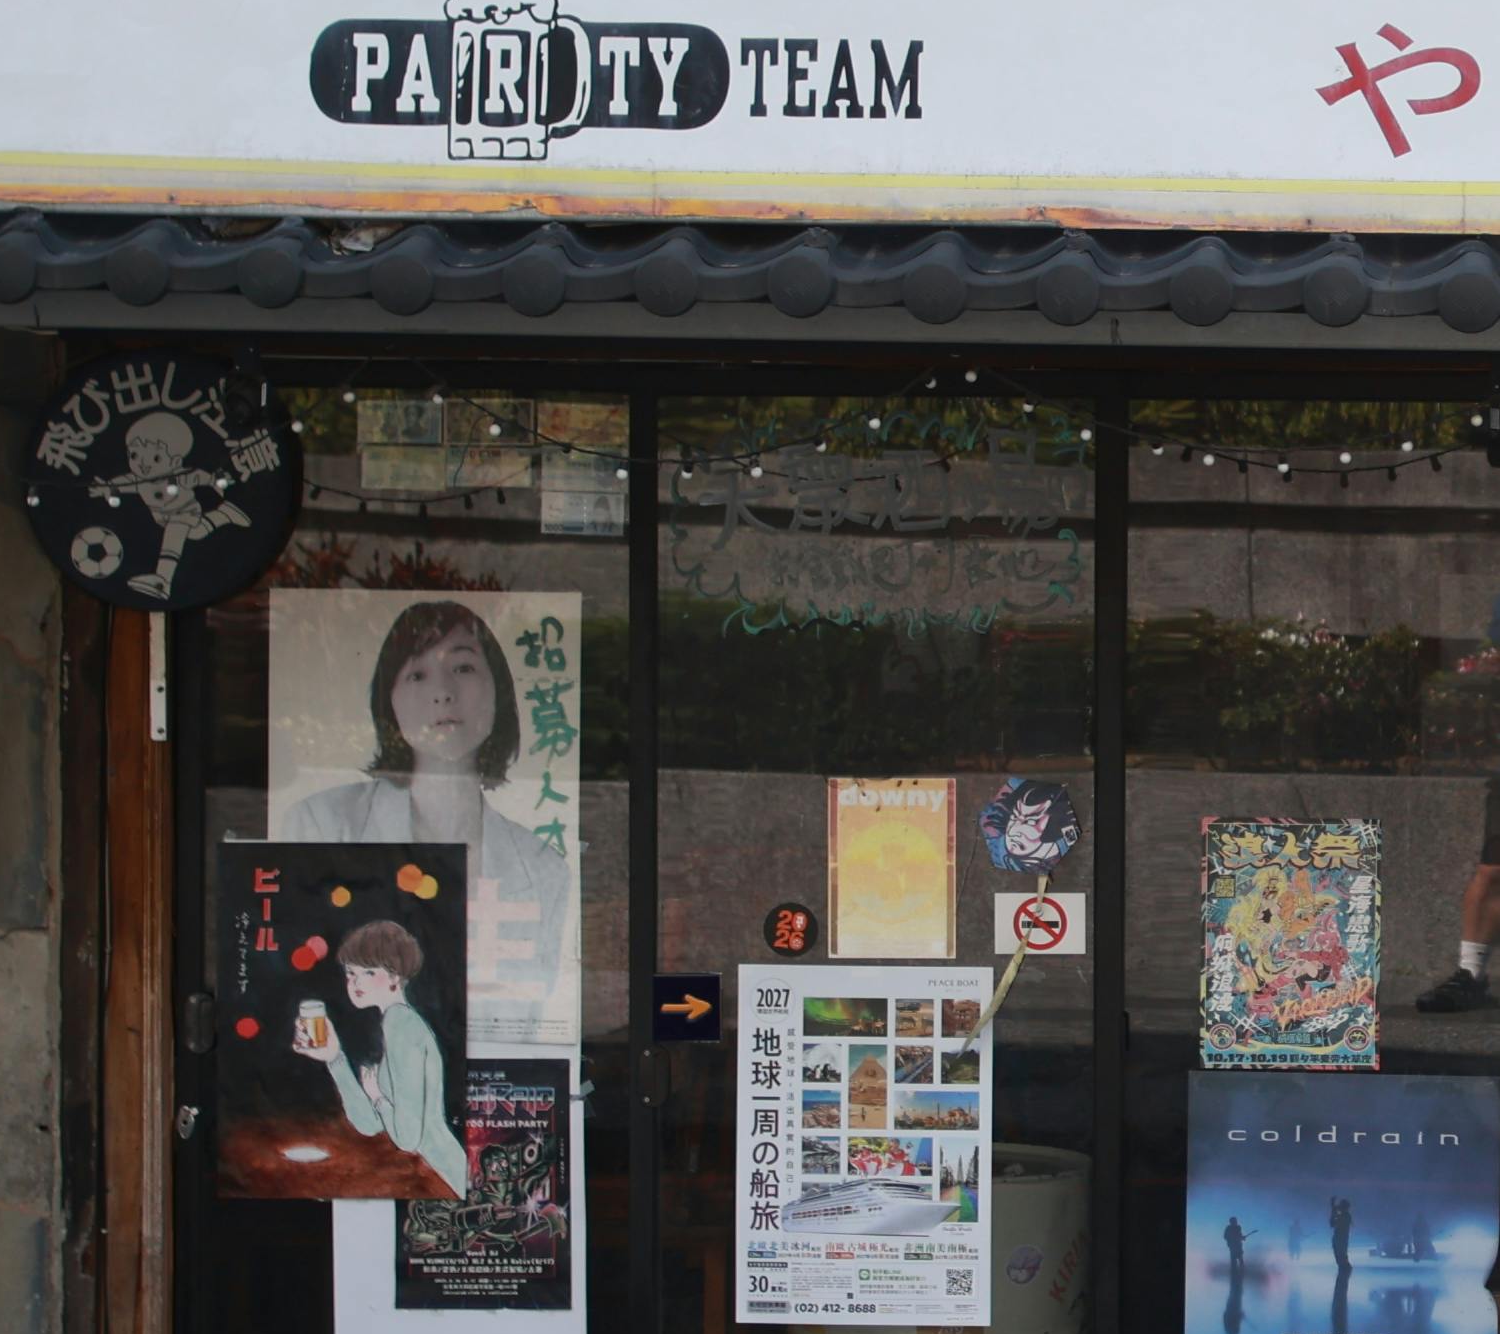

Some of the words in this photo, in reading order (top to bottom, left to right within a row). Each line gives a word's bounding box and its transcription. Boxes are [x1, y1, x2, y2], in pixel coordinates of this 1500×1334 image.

[741, 38, 925, 122] TEAM
[839, 787, 947, 813] downy
[253, 867, 281, 952] ビール
[756, 987, 791, 1009] 2027
[518, 1119, 549, 1129] PARTY
[750, 1027, 782, 1231] 地球一周の船旅
[1227, 1124, 1460, 1146] coldrain
[748, 1275, 769, 1293] 30
[794, 1303, 819, 1314] (02)
[847, 1304, 877, 1314] 8688
